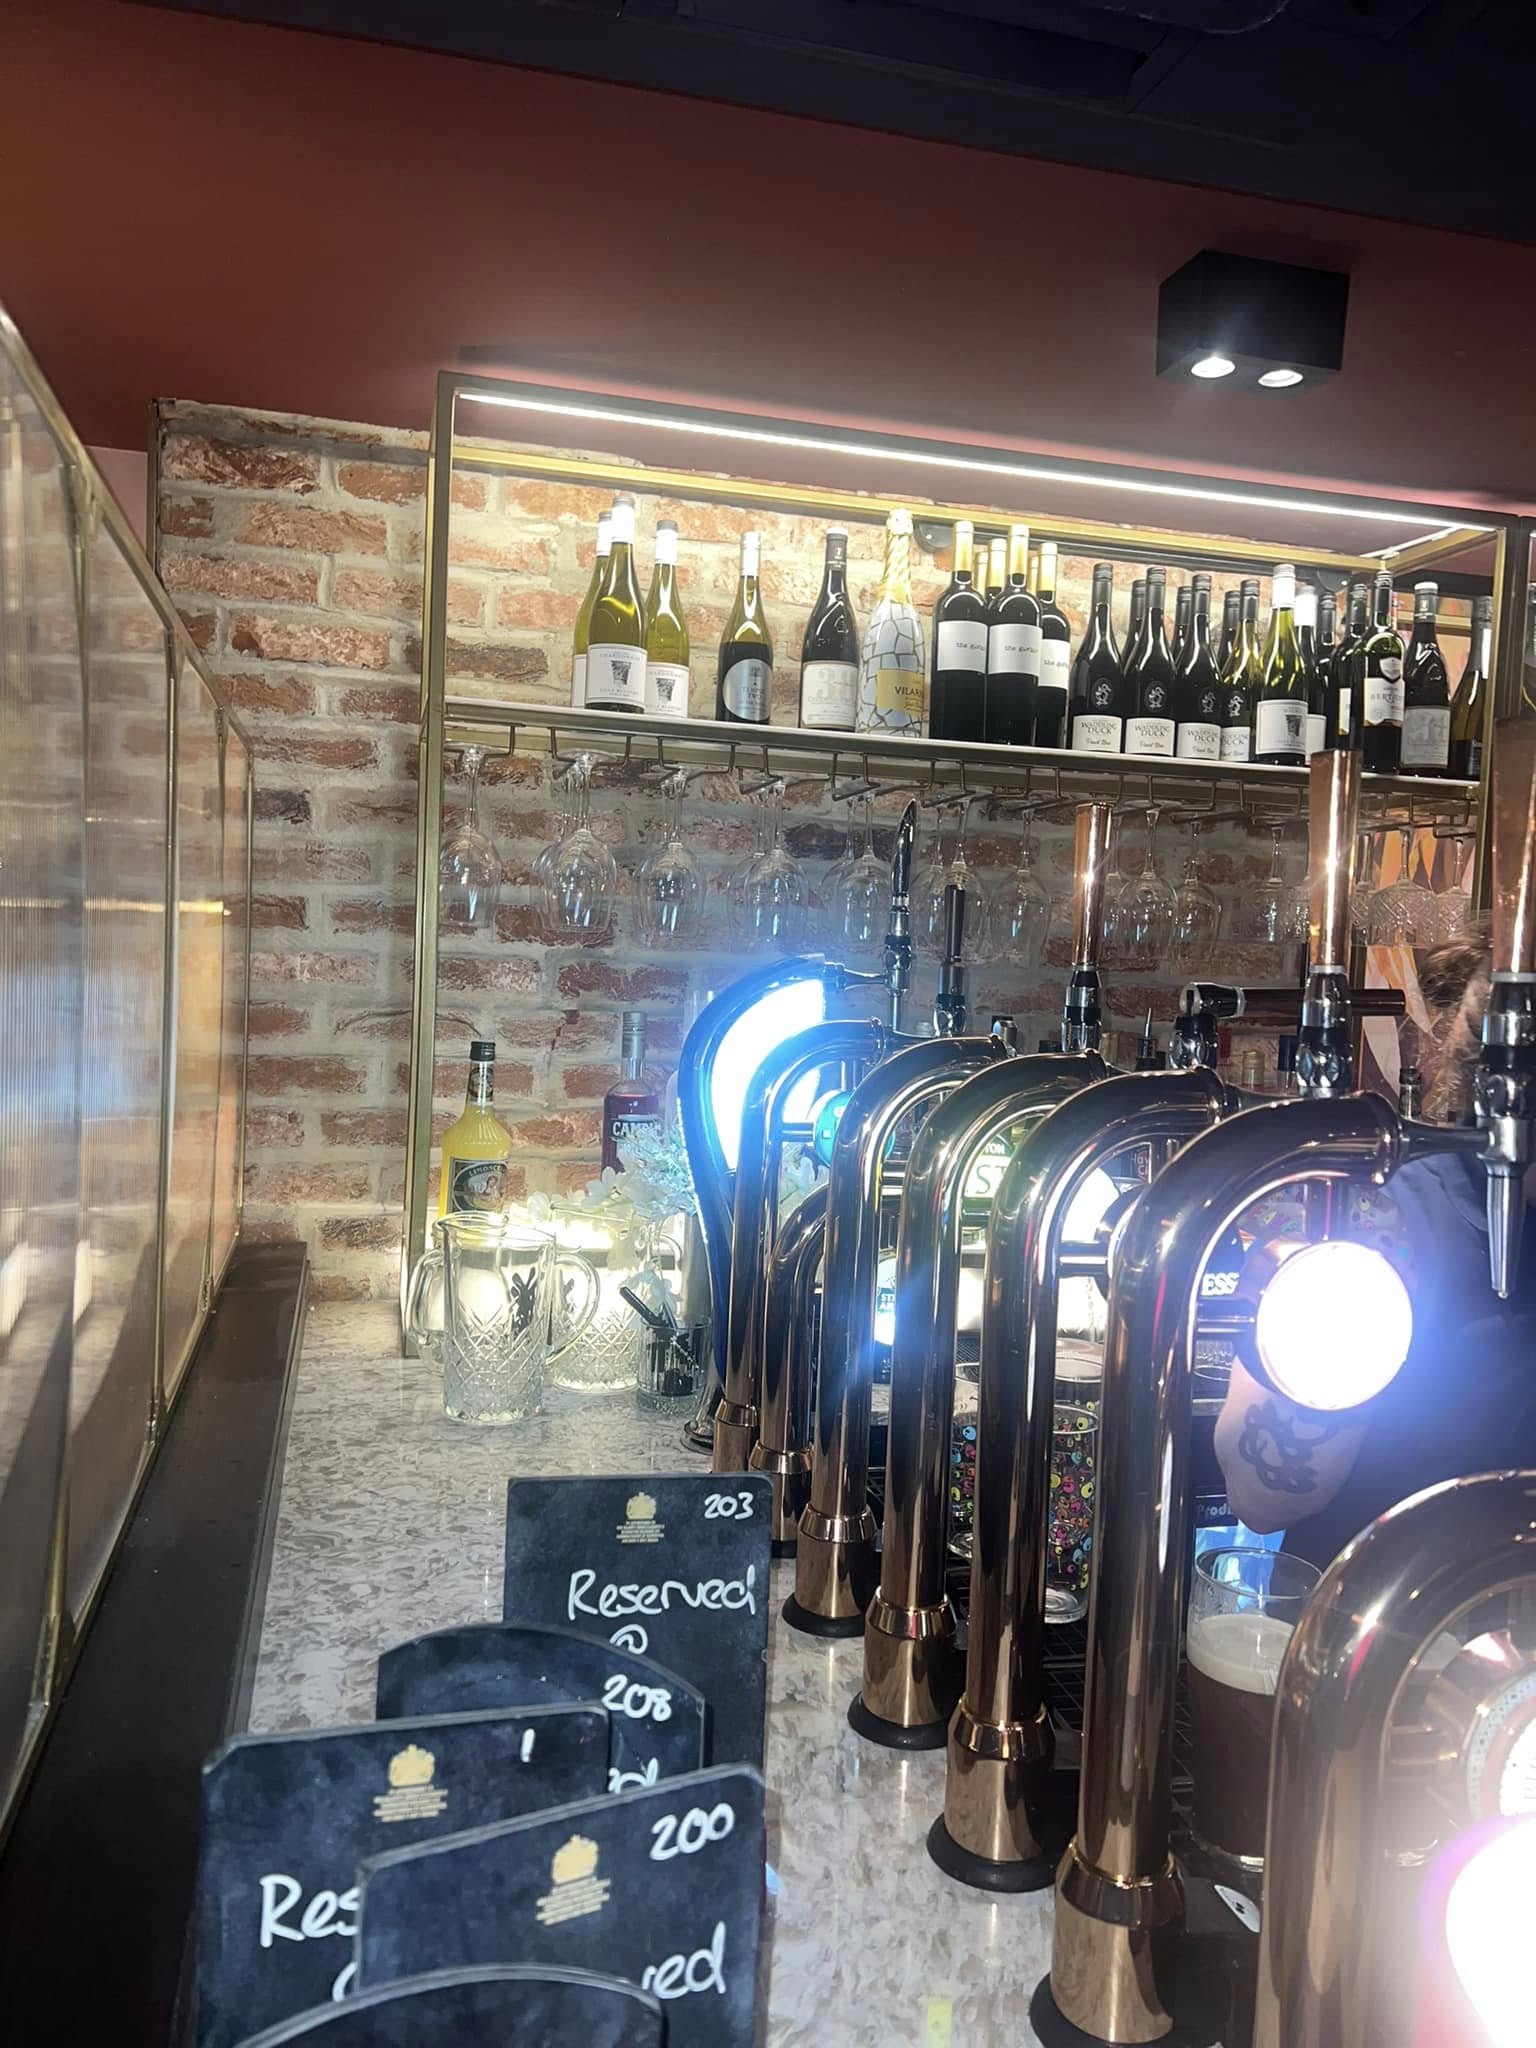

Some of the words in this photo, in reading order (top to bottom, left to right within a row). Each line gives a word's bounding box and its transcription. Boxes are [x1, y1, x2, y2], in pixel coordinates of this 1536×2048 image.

[704, 1491, 754, 1520] 203
[567, 1564, 756, 1621] Reserved
[601, 1673, 673, 1723] 208
[650, 1802, 735, 1860] 200
